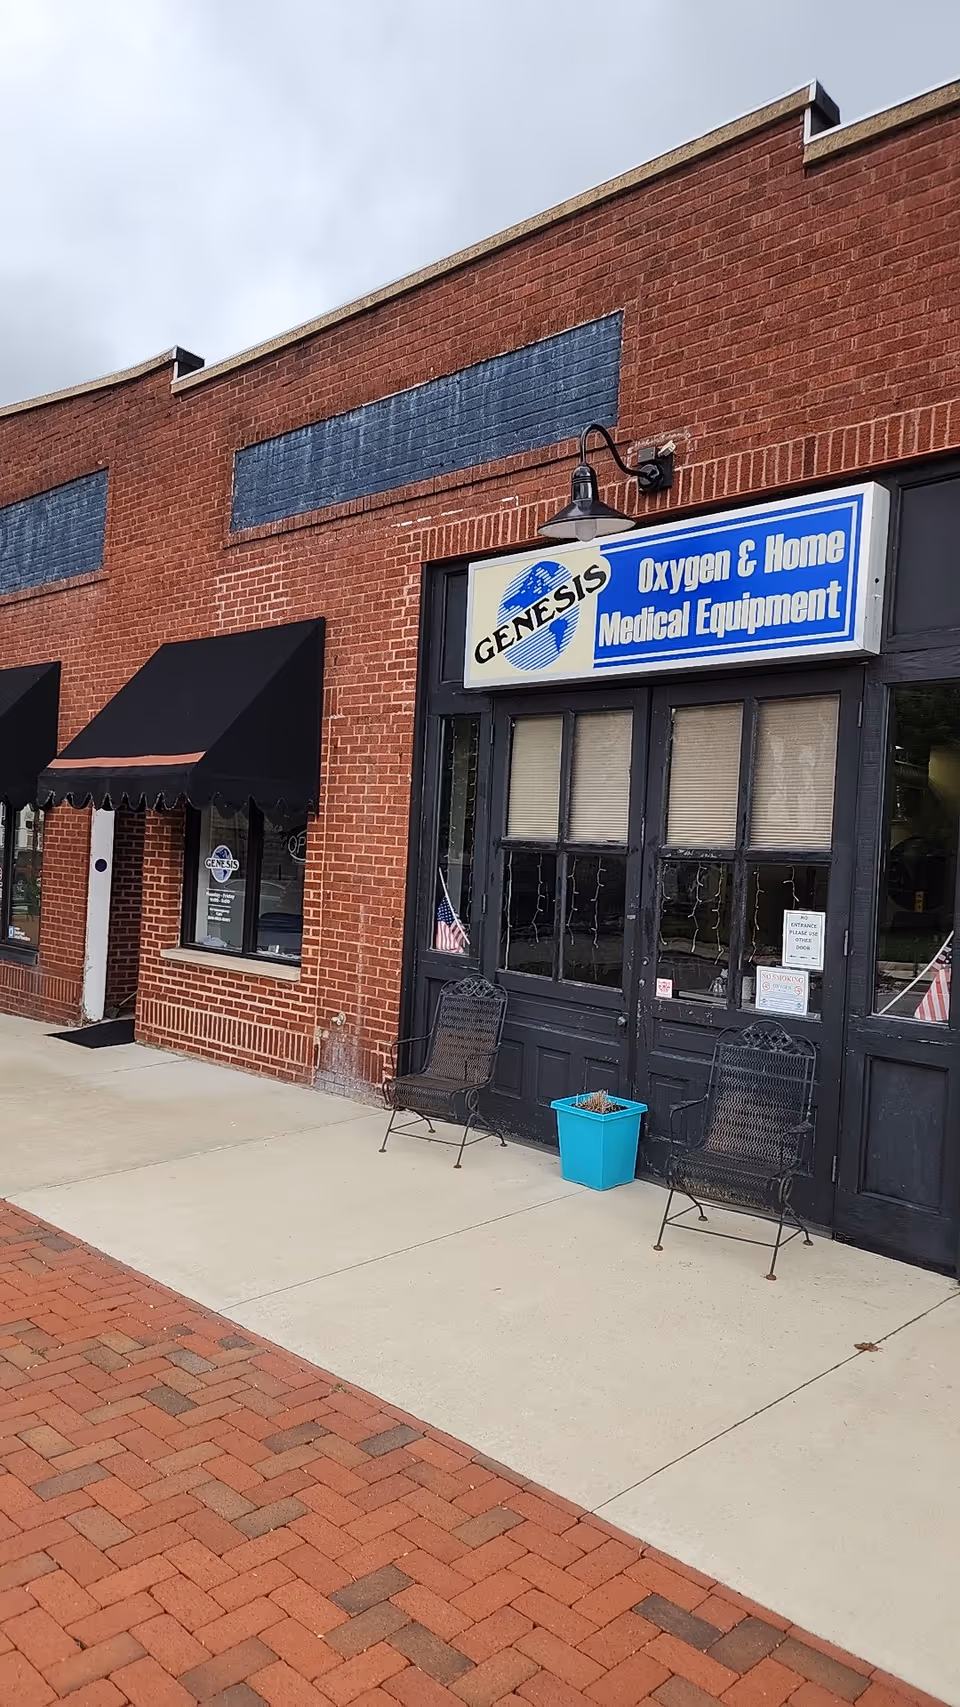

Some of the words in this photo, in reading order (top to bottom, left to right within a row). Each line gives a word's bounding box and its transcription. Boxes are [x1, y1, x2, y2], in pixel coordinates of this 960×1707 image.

[638, 553, 730, 594] Oxygen
[738, 539, 756, 577] &
[764, 529, 846, 573] Home
[474, 563, 607, 664] GENESIS
[598, 601, 689, 647] Medical
[697, 581, 842, 639] Equipment
[206, 859, 238, 869] GENESIS
[288, 836, 306, 853] OP
[762, 972, 772, 980] NO
[772, 973, 804, 984] SMOKING
